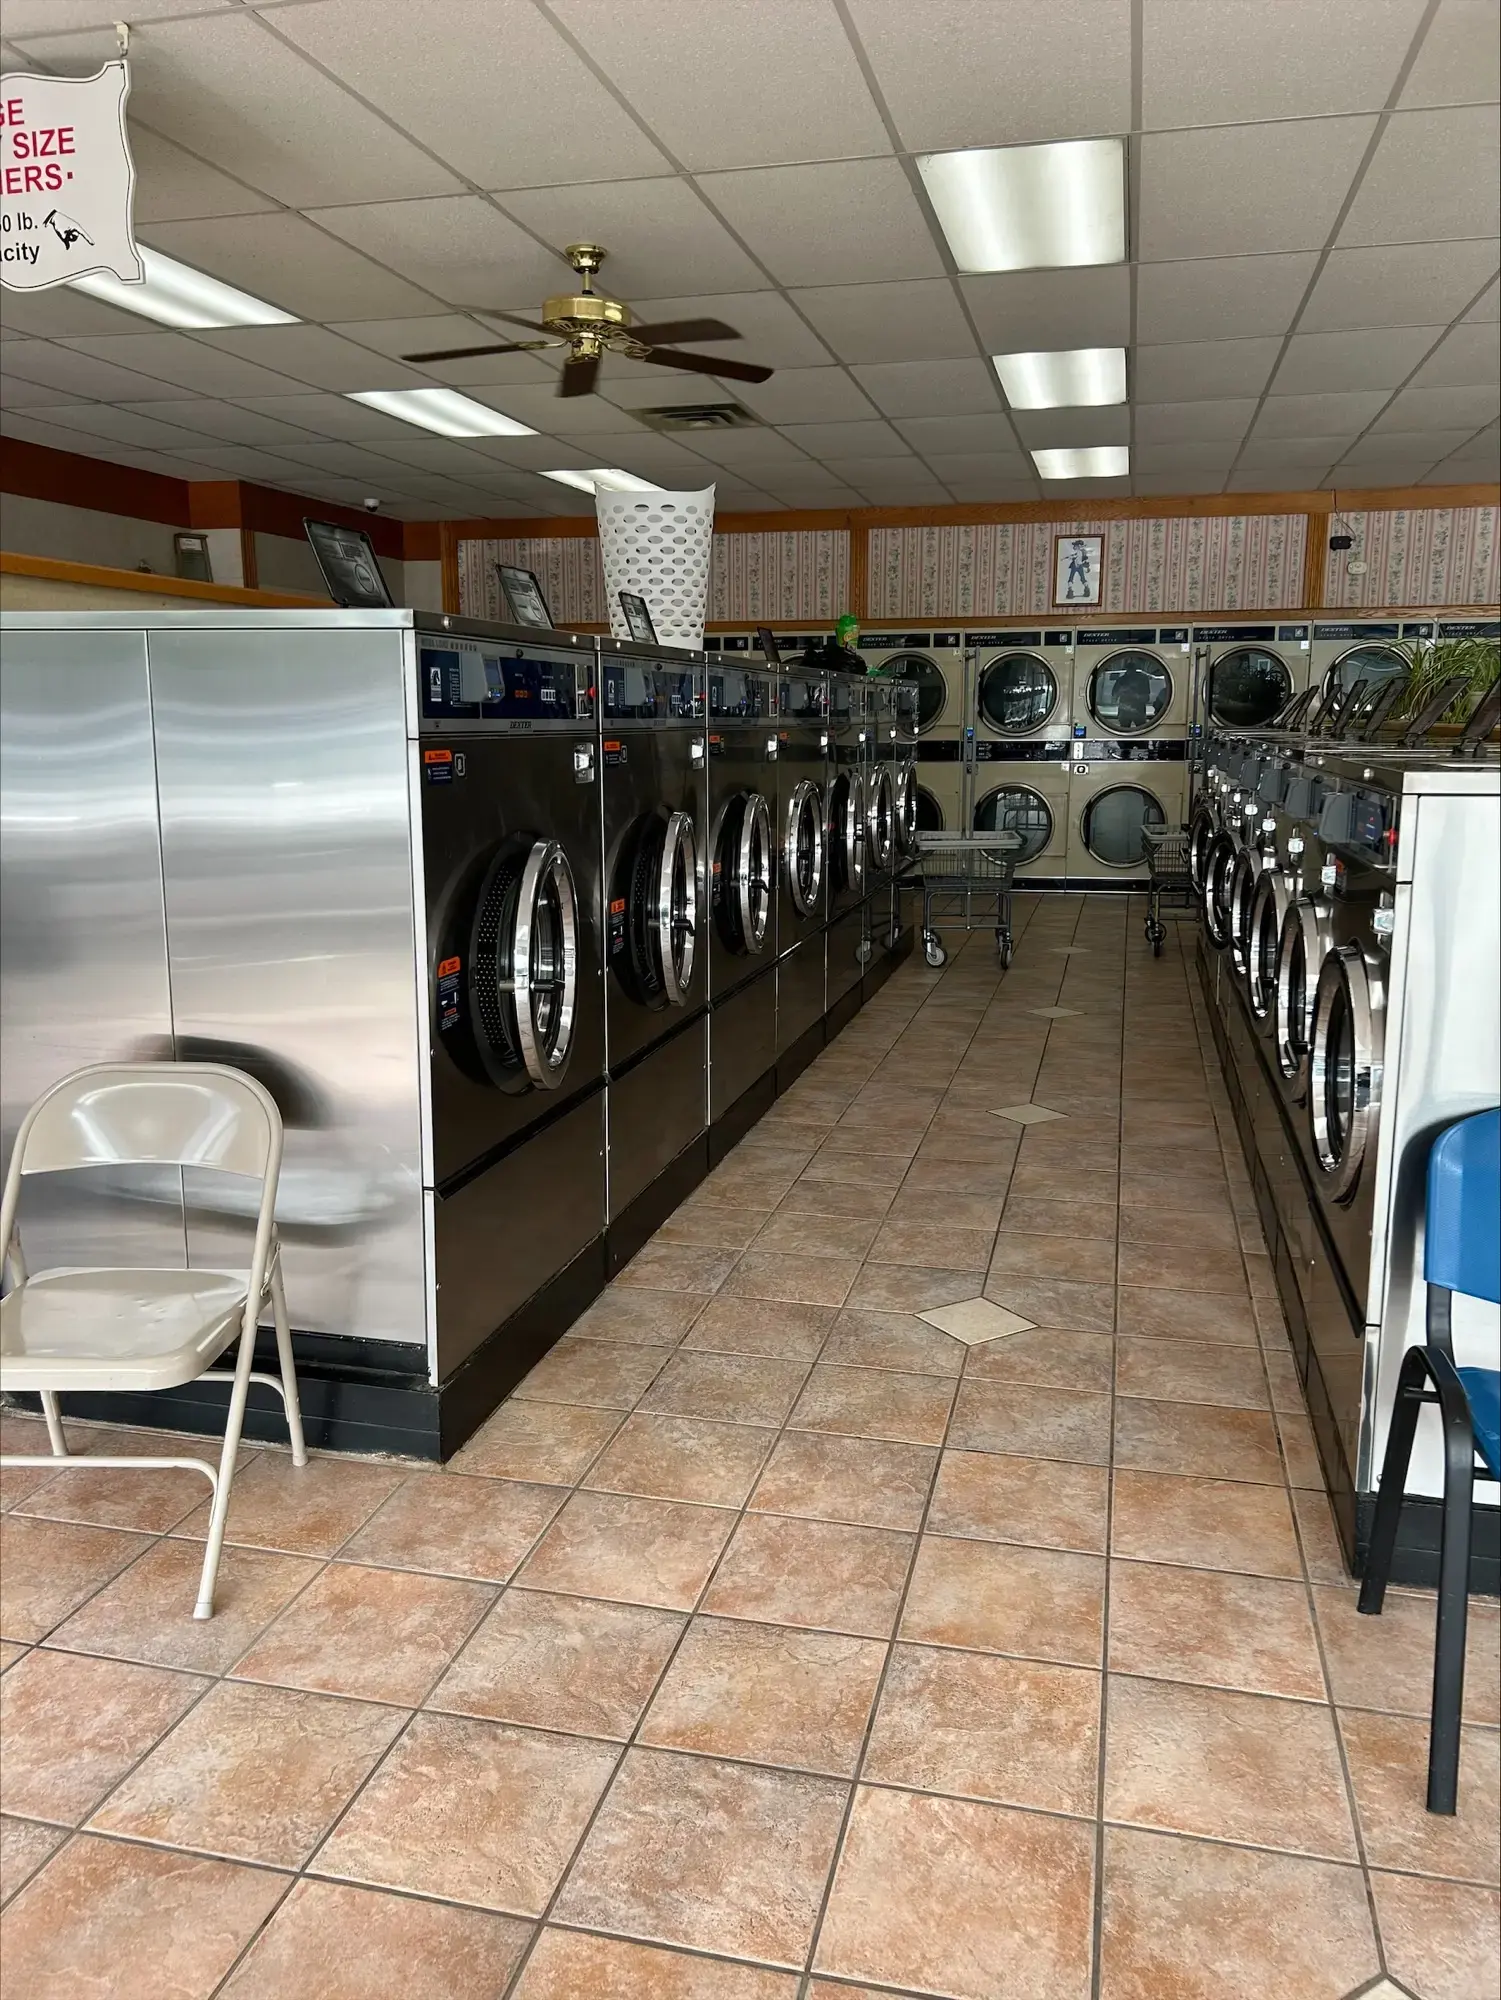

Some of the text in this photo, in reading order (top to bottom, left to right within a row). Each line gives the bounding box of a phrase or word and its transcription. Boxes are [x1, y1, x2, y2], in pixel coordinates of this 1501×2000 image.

[0, 98, 25, 127] E
[13, 127, 76, 159] SIZE
[0, 212, 38, 233] 0 lb.
[0, 242, 40, 265] city
